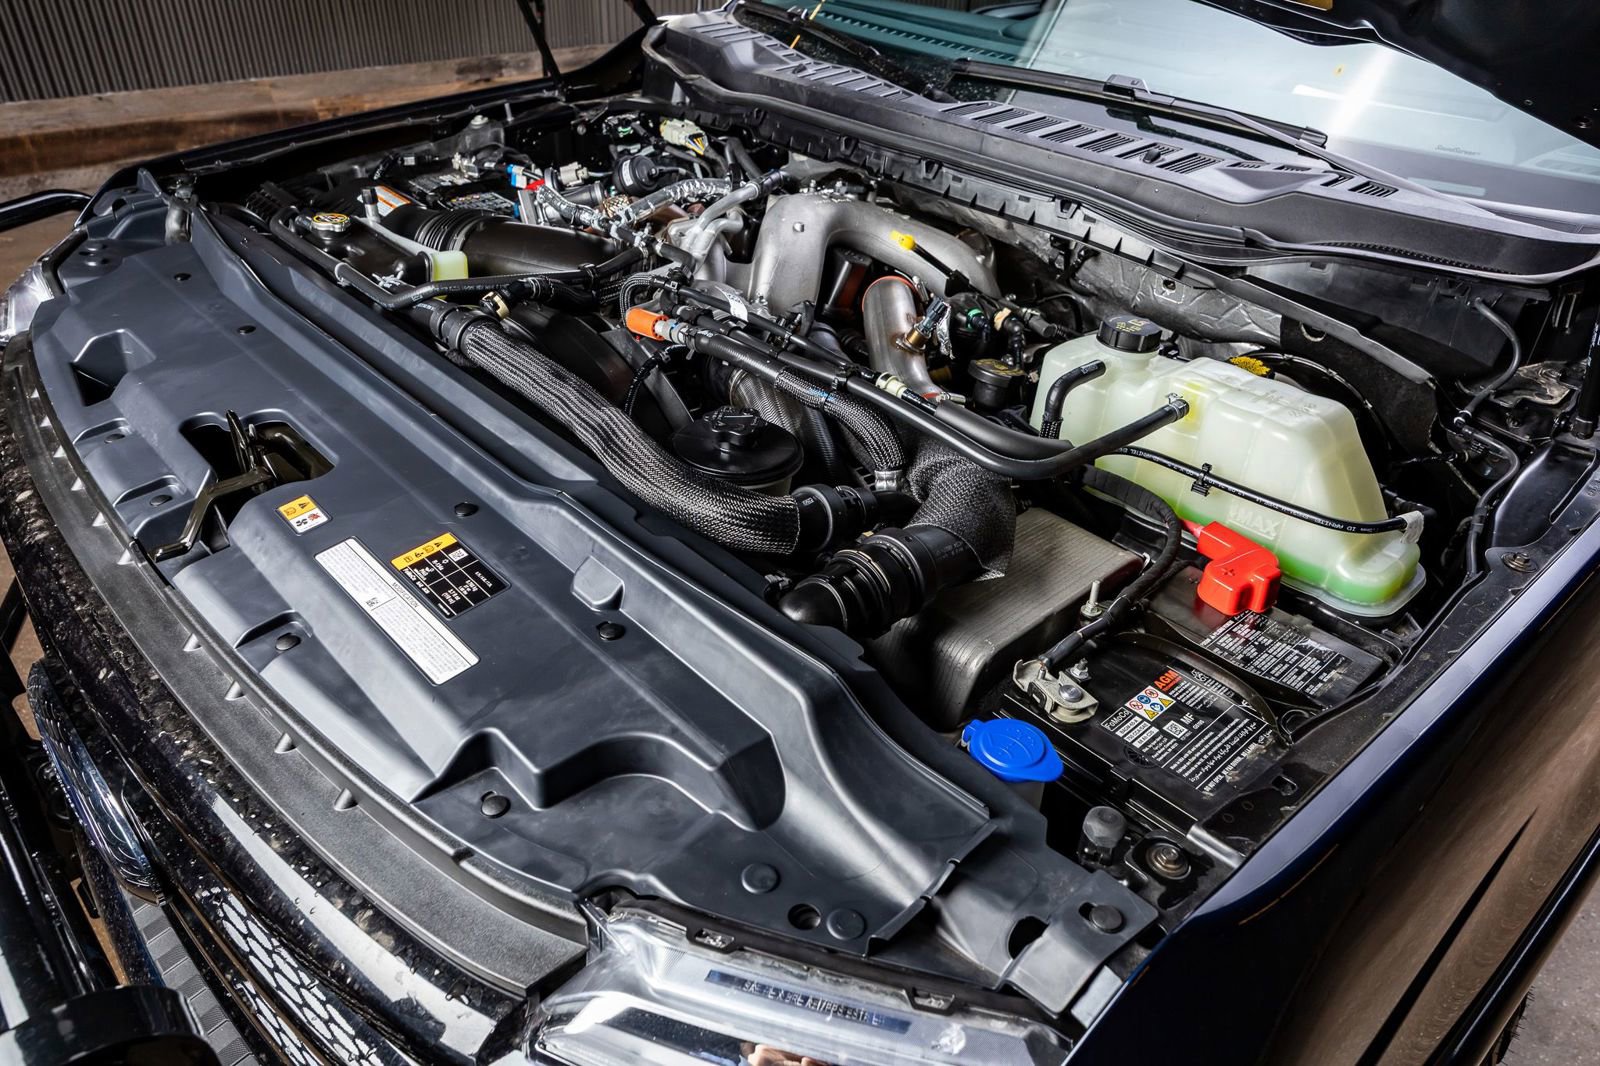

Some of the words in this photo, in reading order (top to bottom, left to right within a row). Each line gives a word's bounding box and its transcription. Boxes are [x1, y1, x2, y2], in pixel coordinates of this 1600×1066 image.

[391, 582, 419, 608] MODIFICATION
[1154, 670, 1179, 690] AGM
[1180, 712, 1195, 725] MF
